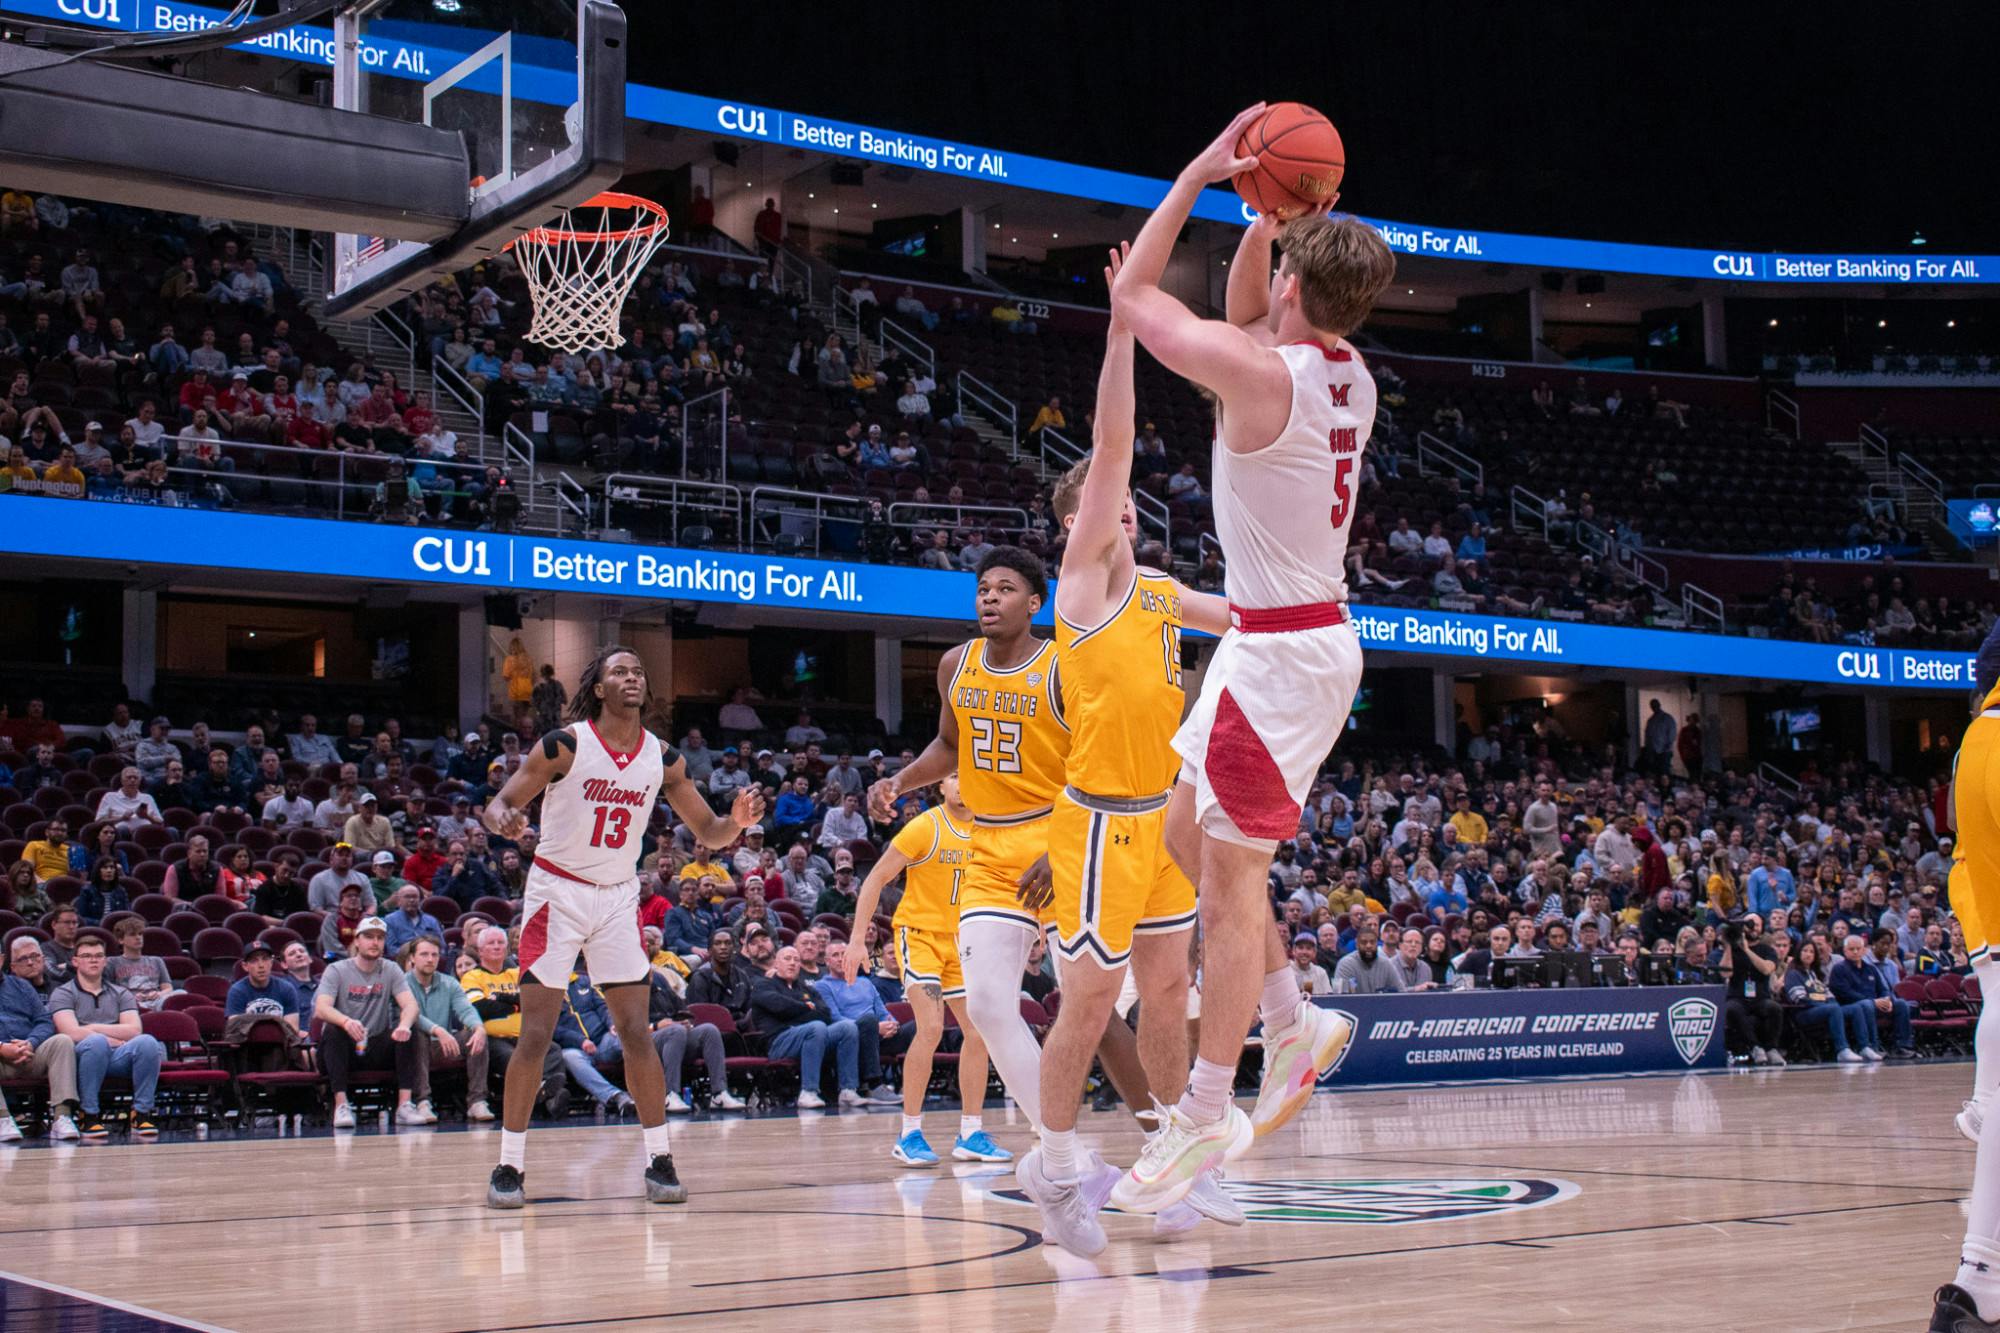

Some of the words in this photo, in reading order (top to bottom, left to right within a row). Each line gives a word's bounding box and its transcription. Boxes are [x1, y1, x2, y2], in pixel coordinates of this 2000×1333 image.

[155, 5, 234, 32] Bett
[243, 27, 336, 64] anking
[357, 40, 388, 66] or
[392, 47, 431, 75] All.
[717, 105, 768, 136] CU1
[793, 119, 854, 150] Better
[859, 131, 937, 168] Banking
[942, 146, 980, 171] For
[978, 153, 1008, 178] All.
[1422, 231, 1450, 253] For
[1454, 235, 1482, 255] All.
[1713, 255, 1755, 277] CU1
[1775, 258, 1832, 278] Better
[1837, 259, 1911, 281] Banking
[1915, 260, 1946, 278] For
[1950, 260, 1980, 278] All.
[1028, 304, 1050, 320] 122
[1328, 383, 1352, 407] M
[13, 475, 80, 493] Huntington
[154, 488, 191, 500] LEEL
[1330, 457, 1353, 529] 5
[412, 536, 491, 576] CU1
[533, 546, 629, 584] Better
[637, 554, 756, 600] Banking
[766, 565, 813, 597] For
[819, 570, 863, 602] All.
[1351, 616, 1399, 641] etter
[1404, 616, 1487, 654] Banking
[1493, 624, 1528, 652] For
[1531, 628, 1563, 655] All.
[1837, 651, 1881, 679] CU1
[1903, 656, 1962, 681] Better
[957, 687, 989, 710] KENT
[994, 691, 1037, 717] STATE
[970, 716, 1022, 774] 23
[583, 778, 650, 807] Miami
[589, 806, 632, 849] 13
[1369, 1016, 1526, 1040] MID-AMERICAN
[1531, 1012, 1660, 1034] CONFERENCE
[1673, 1019, 1713, 1036] MAC
[1406, 1048, 1486, 1064] CELEBRATING
[1487, 1047, 1502, 1060] 25
[1504, 1045, 1541, 1060] YEARS
[1544, 1044, 1557, 1058] IN
[1559, 1042, 1624, 1057] CLEVELAND
